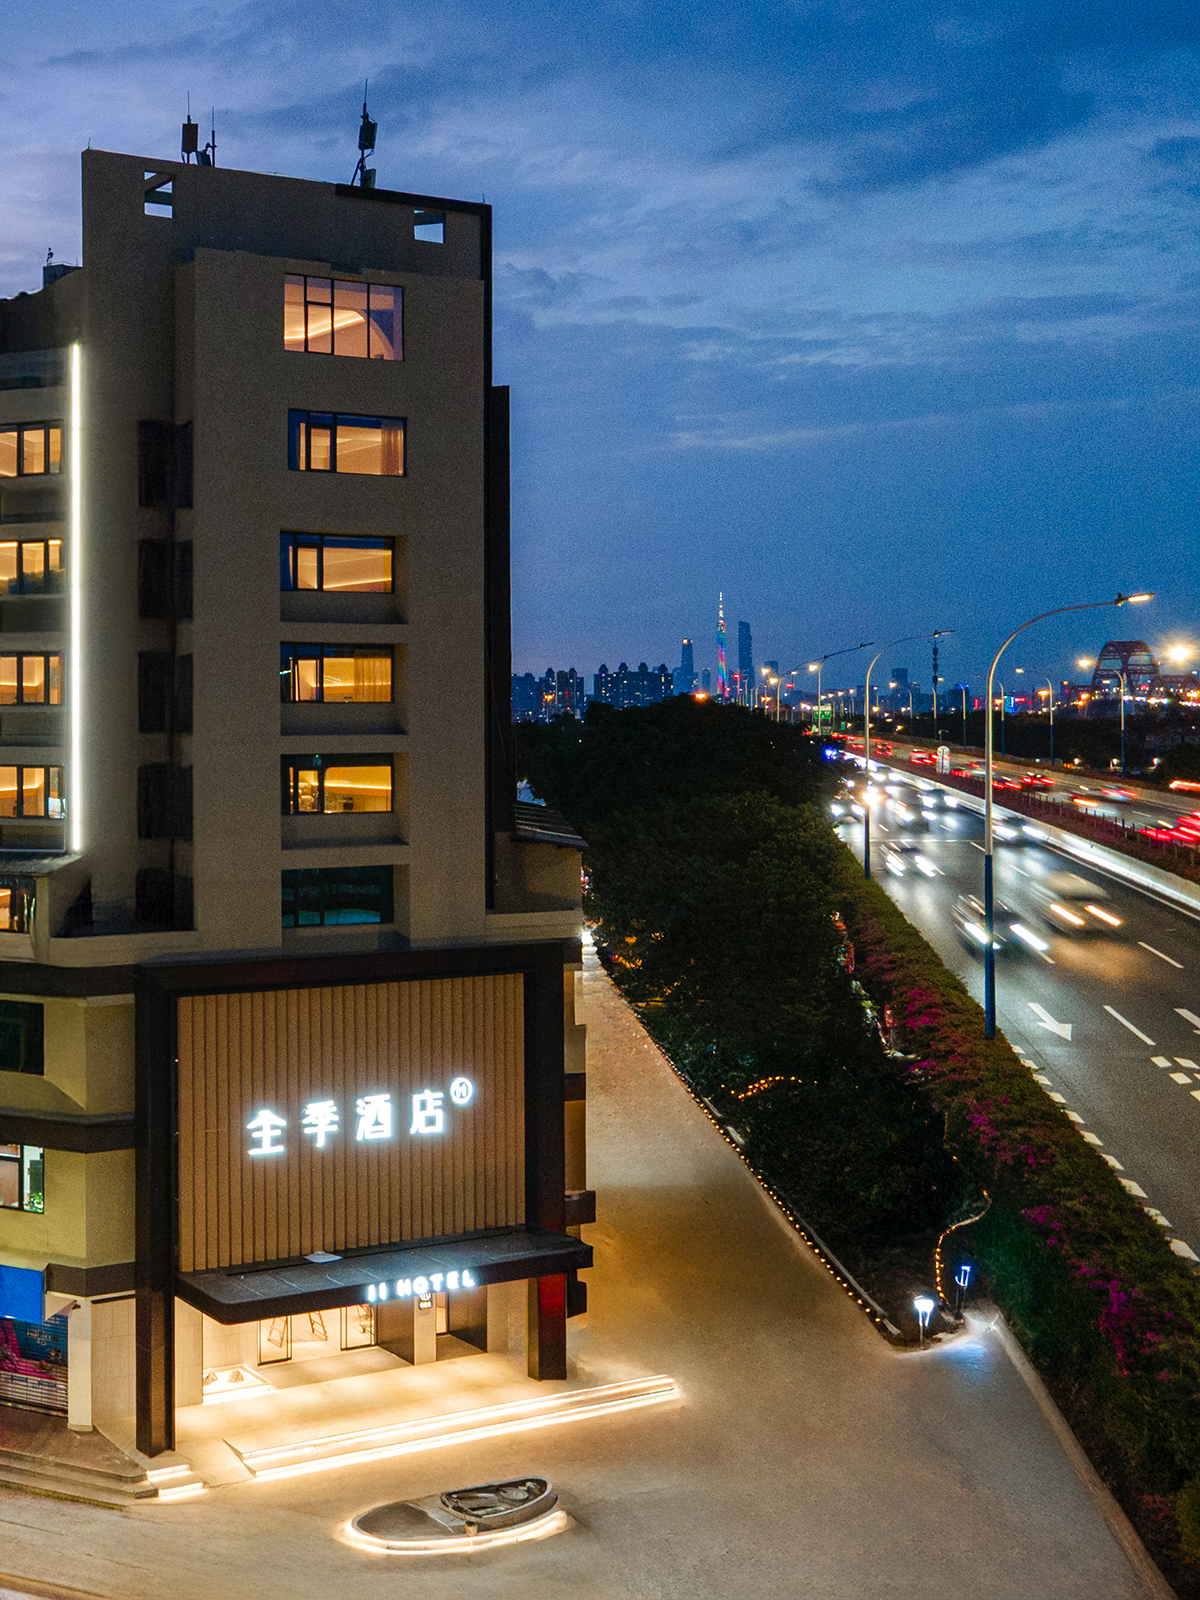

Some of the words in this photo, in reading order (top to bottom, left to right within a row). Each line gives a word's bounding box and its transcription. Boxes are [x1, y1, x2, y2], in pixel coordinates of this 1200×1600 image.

[246, 1089, 444, 1156] 全季酒店
[396, 1269, 475, 1298] HOTEL
